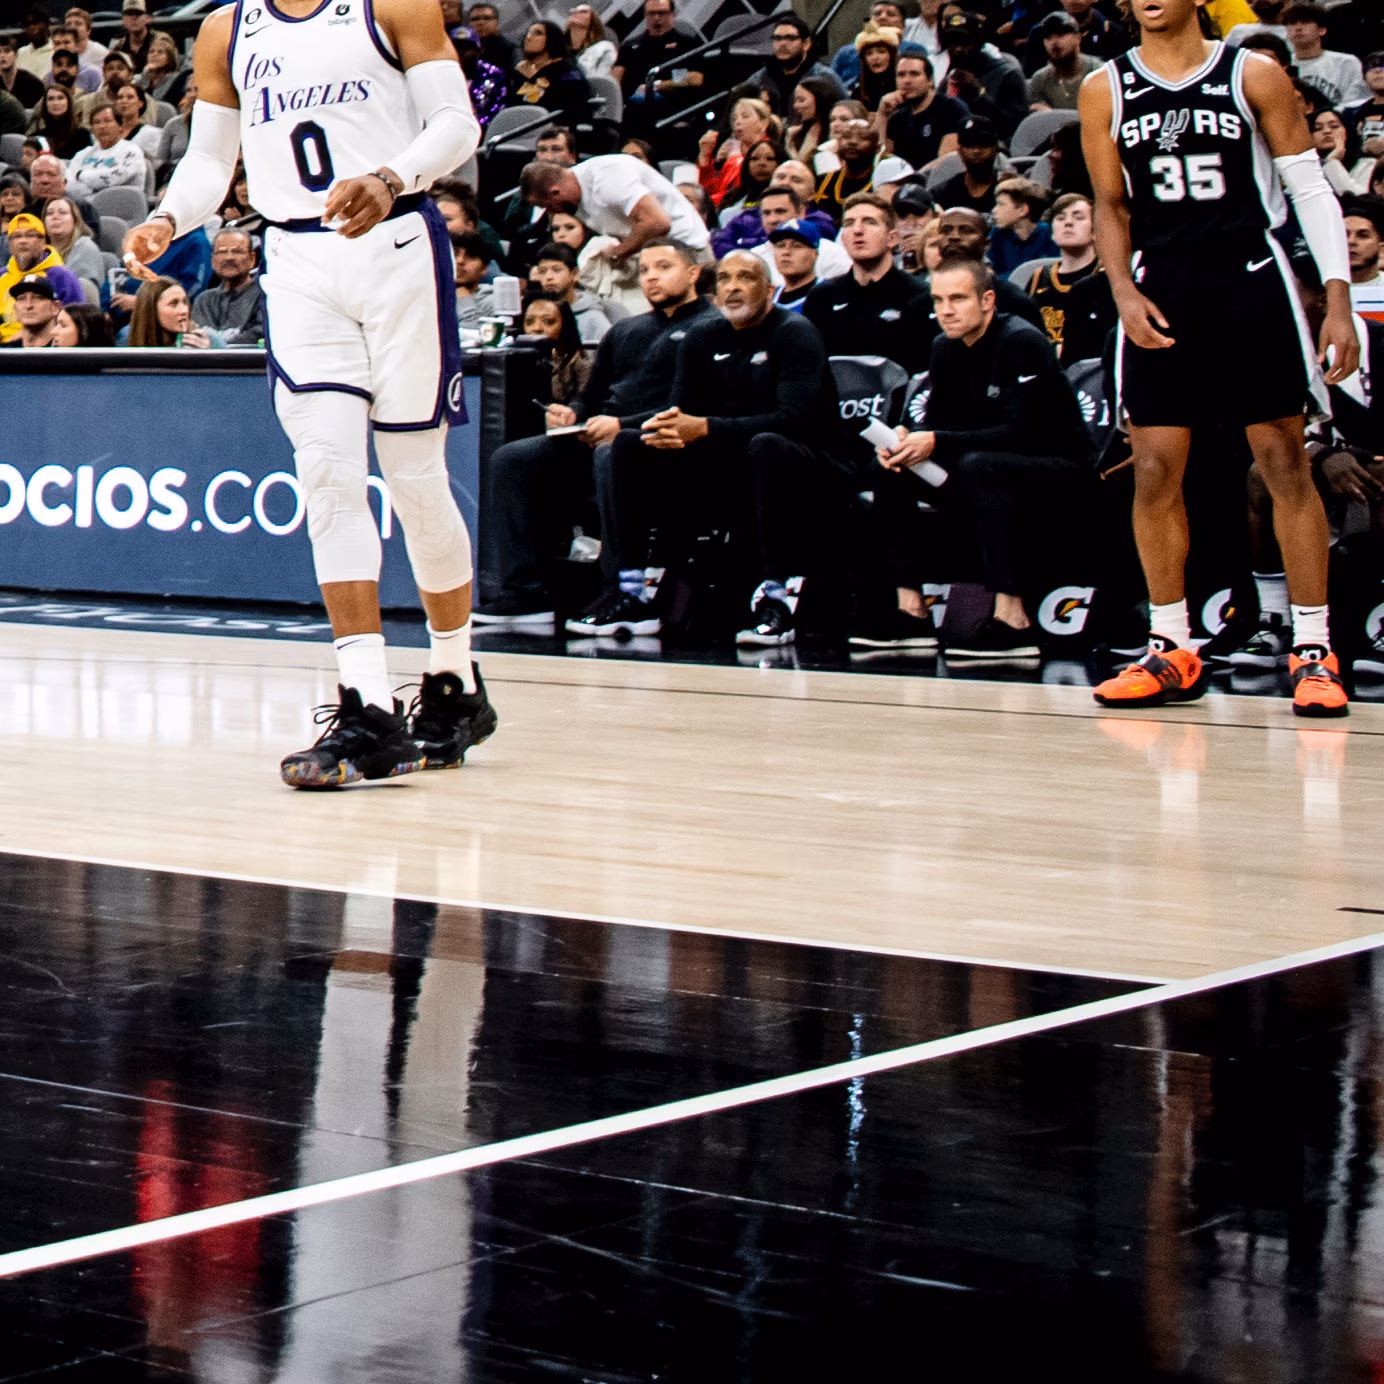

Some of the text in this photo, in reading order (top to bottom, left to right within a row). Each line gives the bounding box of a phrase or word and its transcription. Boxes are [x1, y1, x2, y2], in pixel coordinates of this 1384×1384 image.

[290, 120, 335, 192] 0
[1149, 152, 1226, 202] 35
[839, 394, 885, 419] ost
[1037, 586, 1096, 635] G
